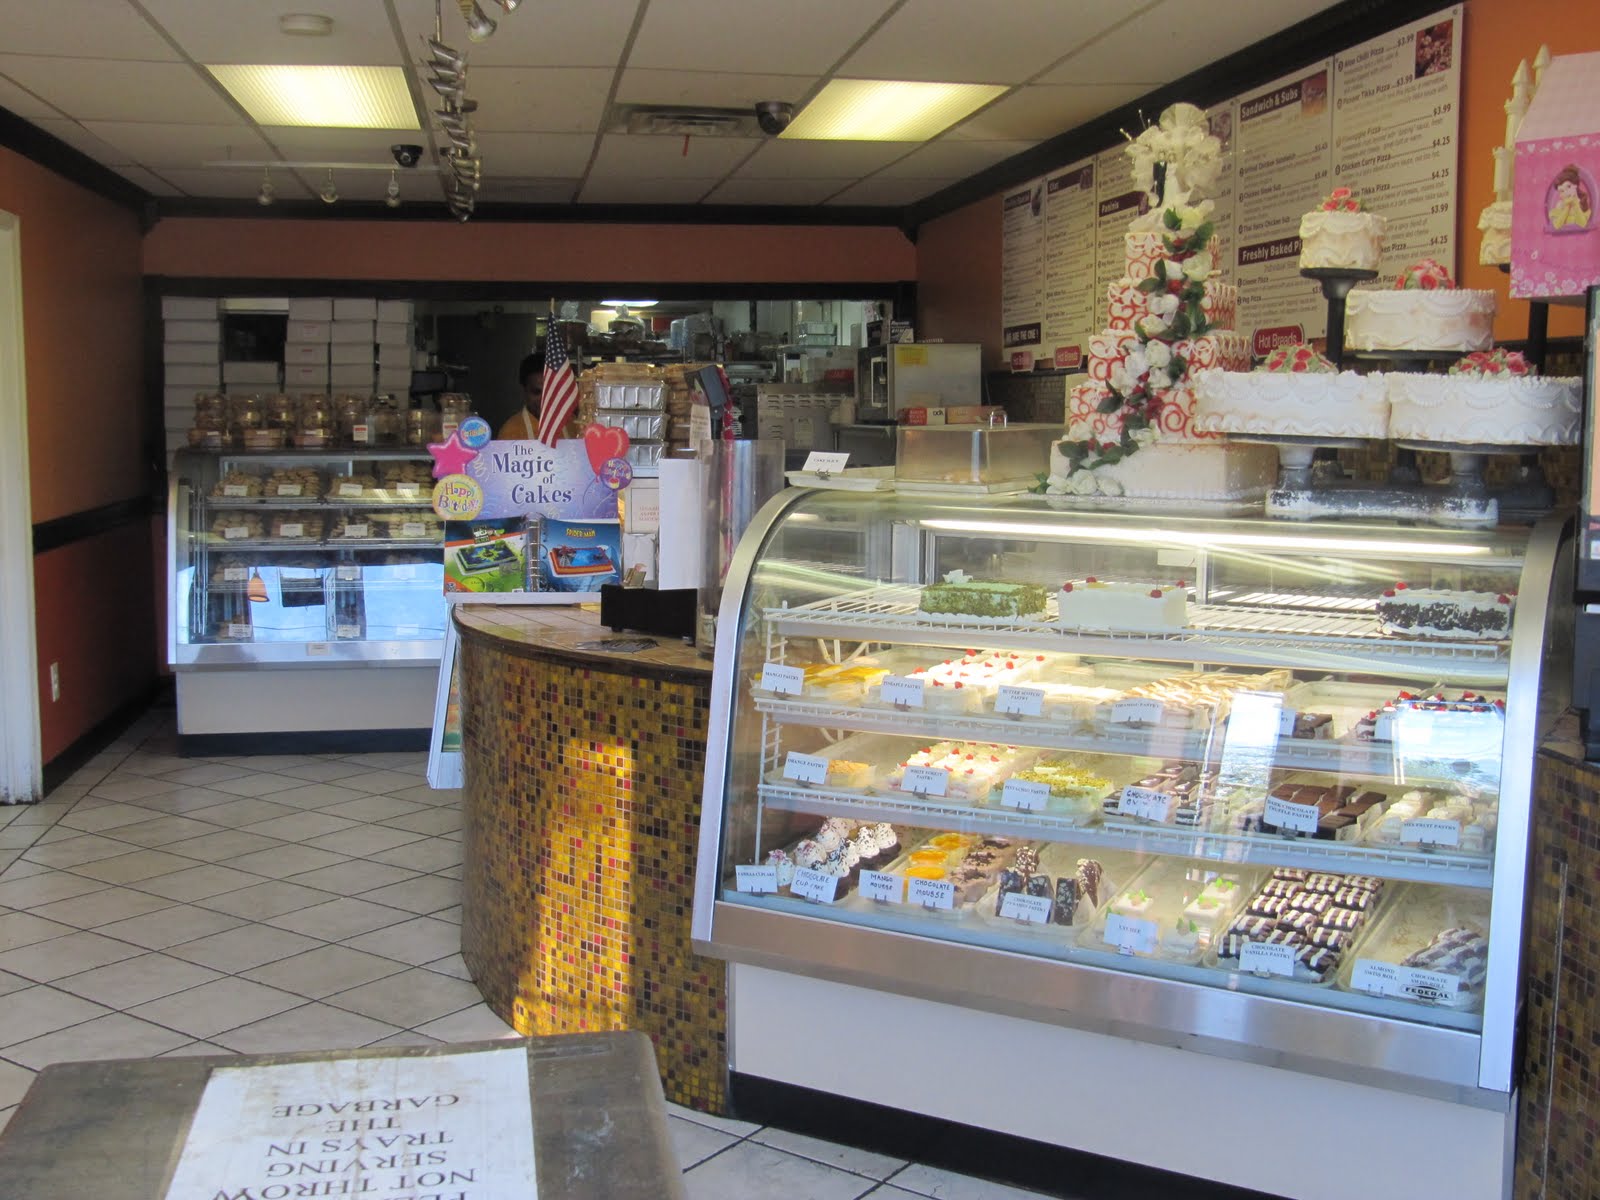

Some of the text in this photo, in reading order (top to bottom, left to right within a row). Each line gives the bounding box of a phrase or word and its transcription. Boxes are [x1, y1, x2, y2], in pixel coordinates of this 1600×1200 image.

[1370, 47, 1384, 58] Pizza
[1397, 33, 1414, 47] $3.99
[1376, 84, 1390, 94] Pizza
[1396, 74, 1413, 87] $3.99
[1242, 88, 1298, 118] Sandwich & Subs
[1433, 103, 1451, 117] $3.99
[1341, 135, 1451, 172] Chicken Curry Pizza $4.25
[1361, 186, 1375, 195] Tikka
[1376, 184, 1390, 192] Pizza
[1432, 168, 1450, 180] $4.25
[1431, 203, 1449, 215] $3.99
[1392, 242, 1406, 252] Pizza
[1430, 234, 1448, 246] $4.25
[1242, 248, 1269, 261] Freshly
[1270, 242, 1293, 257] Baked
[1382, 274, 1398, 283] Pizza
[1258, 332, 1298, 348] Hot Breads
[512, 444, 534, 456] The
[492, 452, 554, 479] Magic
[542, 473, 556, 484] of
[444, 482, 475, 498] Happy
[511, 483, 573, 505] Cakes
[764, 671, 782, 679] MANGO
[787, 758, 825, 769] ORANGE PASTRY
[1282, 804, 1316, 814] CHOCOLATE
[1292, 812, 1313, 820] PASTRY
[795, 879, 809, 887] CUP
[796, 869, 830, 884] CHOCOLATE
[870, 872, 894, 882] MANGO
[914, 880, 950, 891] CHOCOLATE
[916, 889, 945, 899] MOUSSE
[1252, 944, 1285, 952] CHOCOLATE
[1269, 952, 1290, 960] PASTRY
[1364, 970, 1398, 981] SWISS ROLL
[1370, 965, 1395, 974] ALMOND
[1410, 972, 1448, 984] CHOCOLATE
[1404, 986, 1450, 999] FEDERAL
[272, 1094, 460, 1118] GARBAGE
[325, 1117, 401, 1134] THE
[264, 1131, 454, 1156] TRAYS IN
[266, 1150, 448, 1178] SERVING
[389, 1168, 477, 1191] NOT
